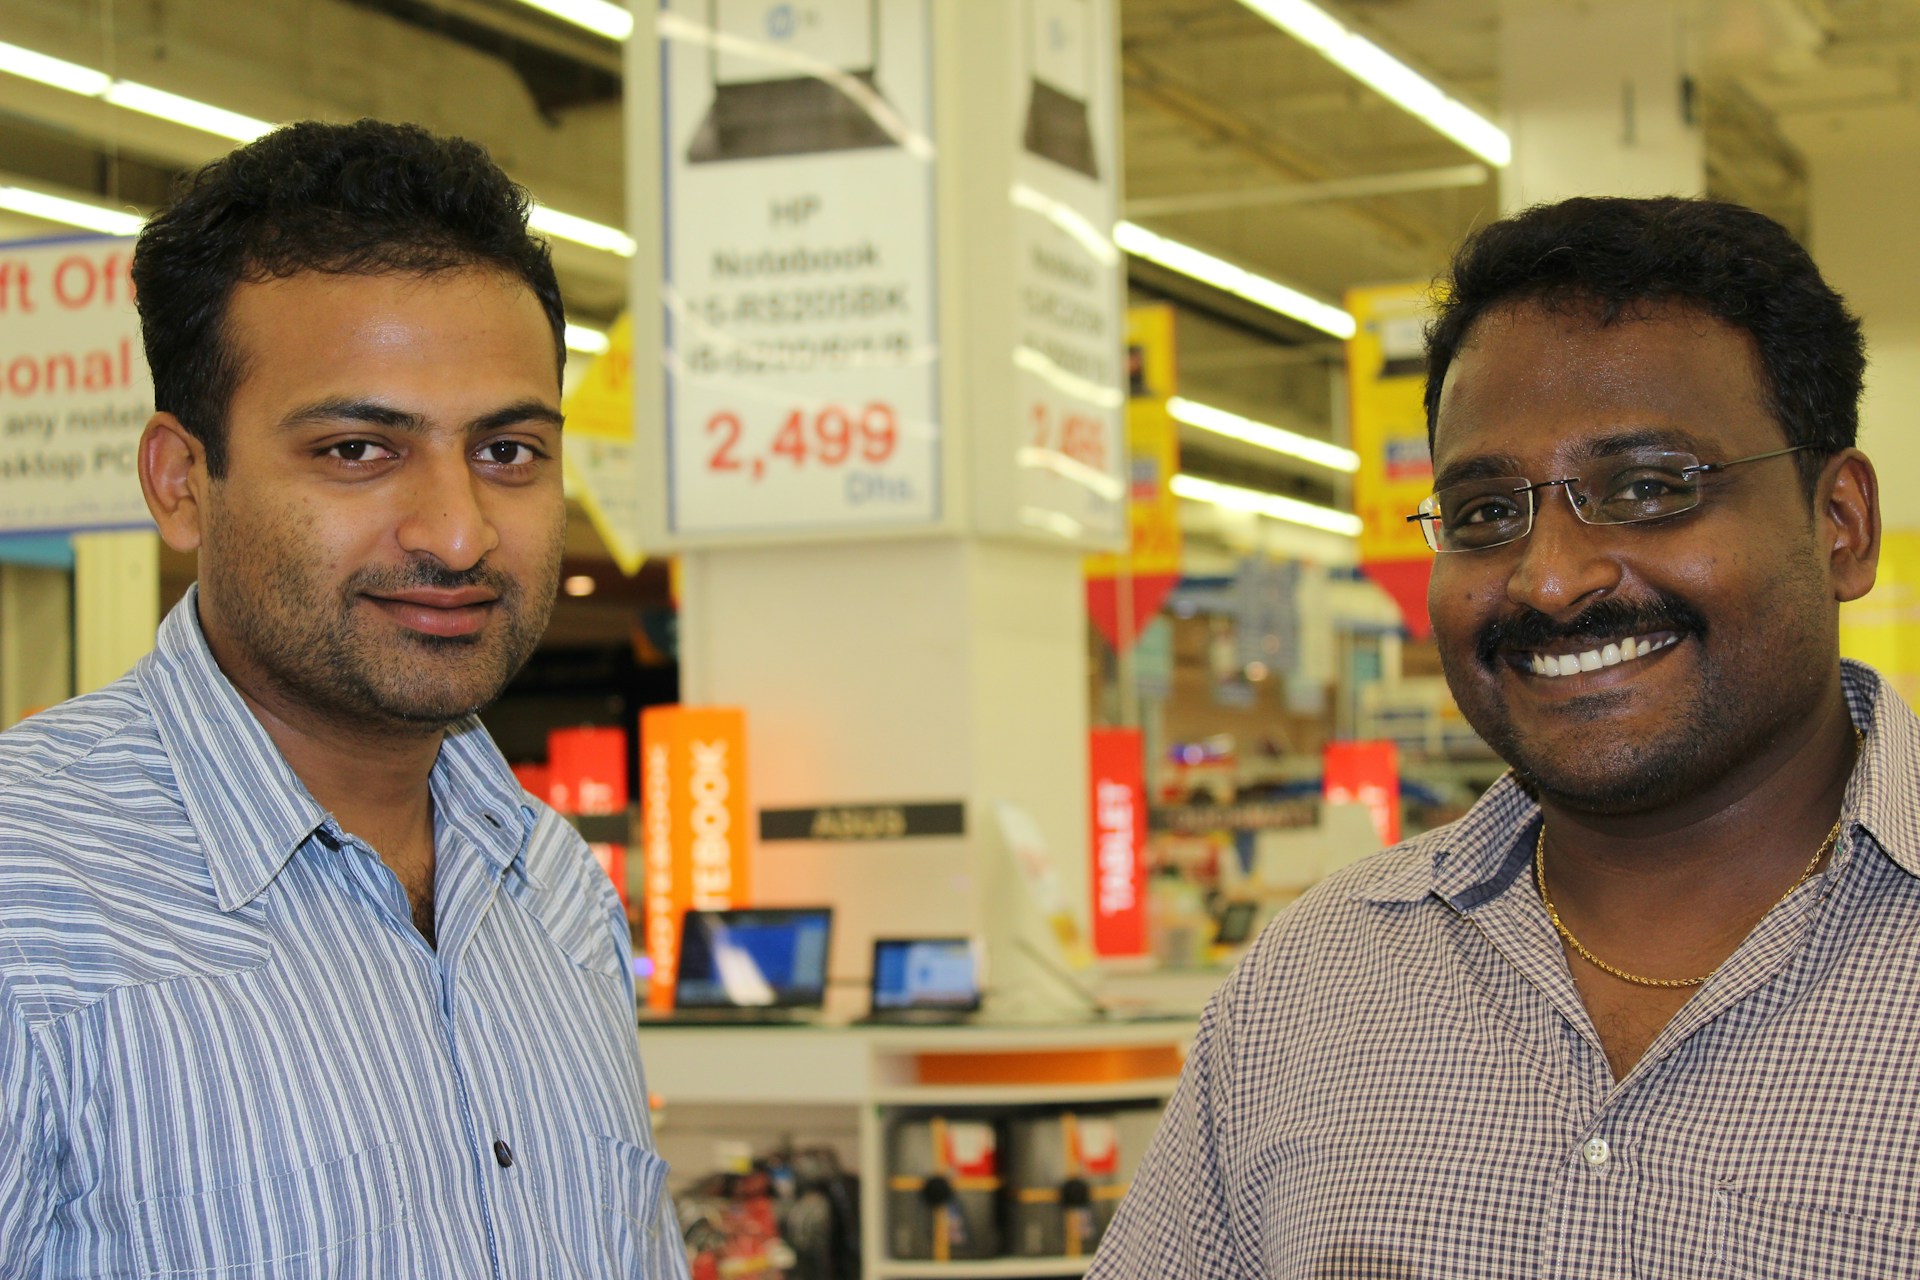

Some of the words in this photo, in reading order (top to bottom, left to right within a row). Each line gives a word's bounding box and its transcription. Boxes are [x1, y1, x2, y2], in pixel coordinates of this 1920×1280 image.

[712, 244, 878, 278] Notebook
[0, 336, 131, 398] onal
[705, 400, 898, 484] 2,499
[1098, 777, 1135, 917] TABLET
